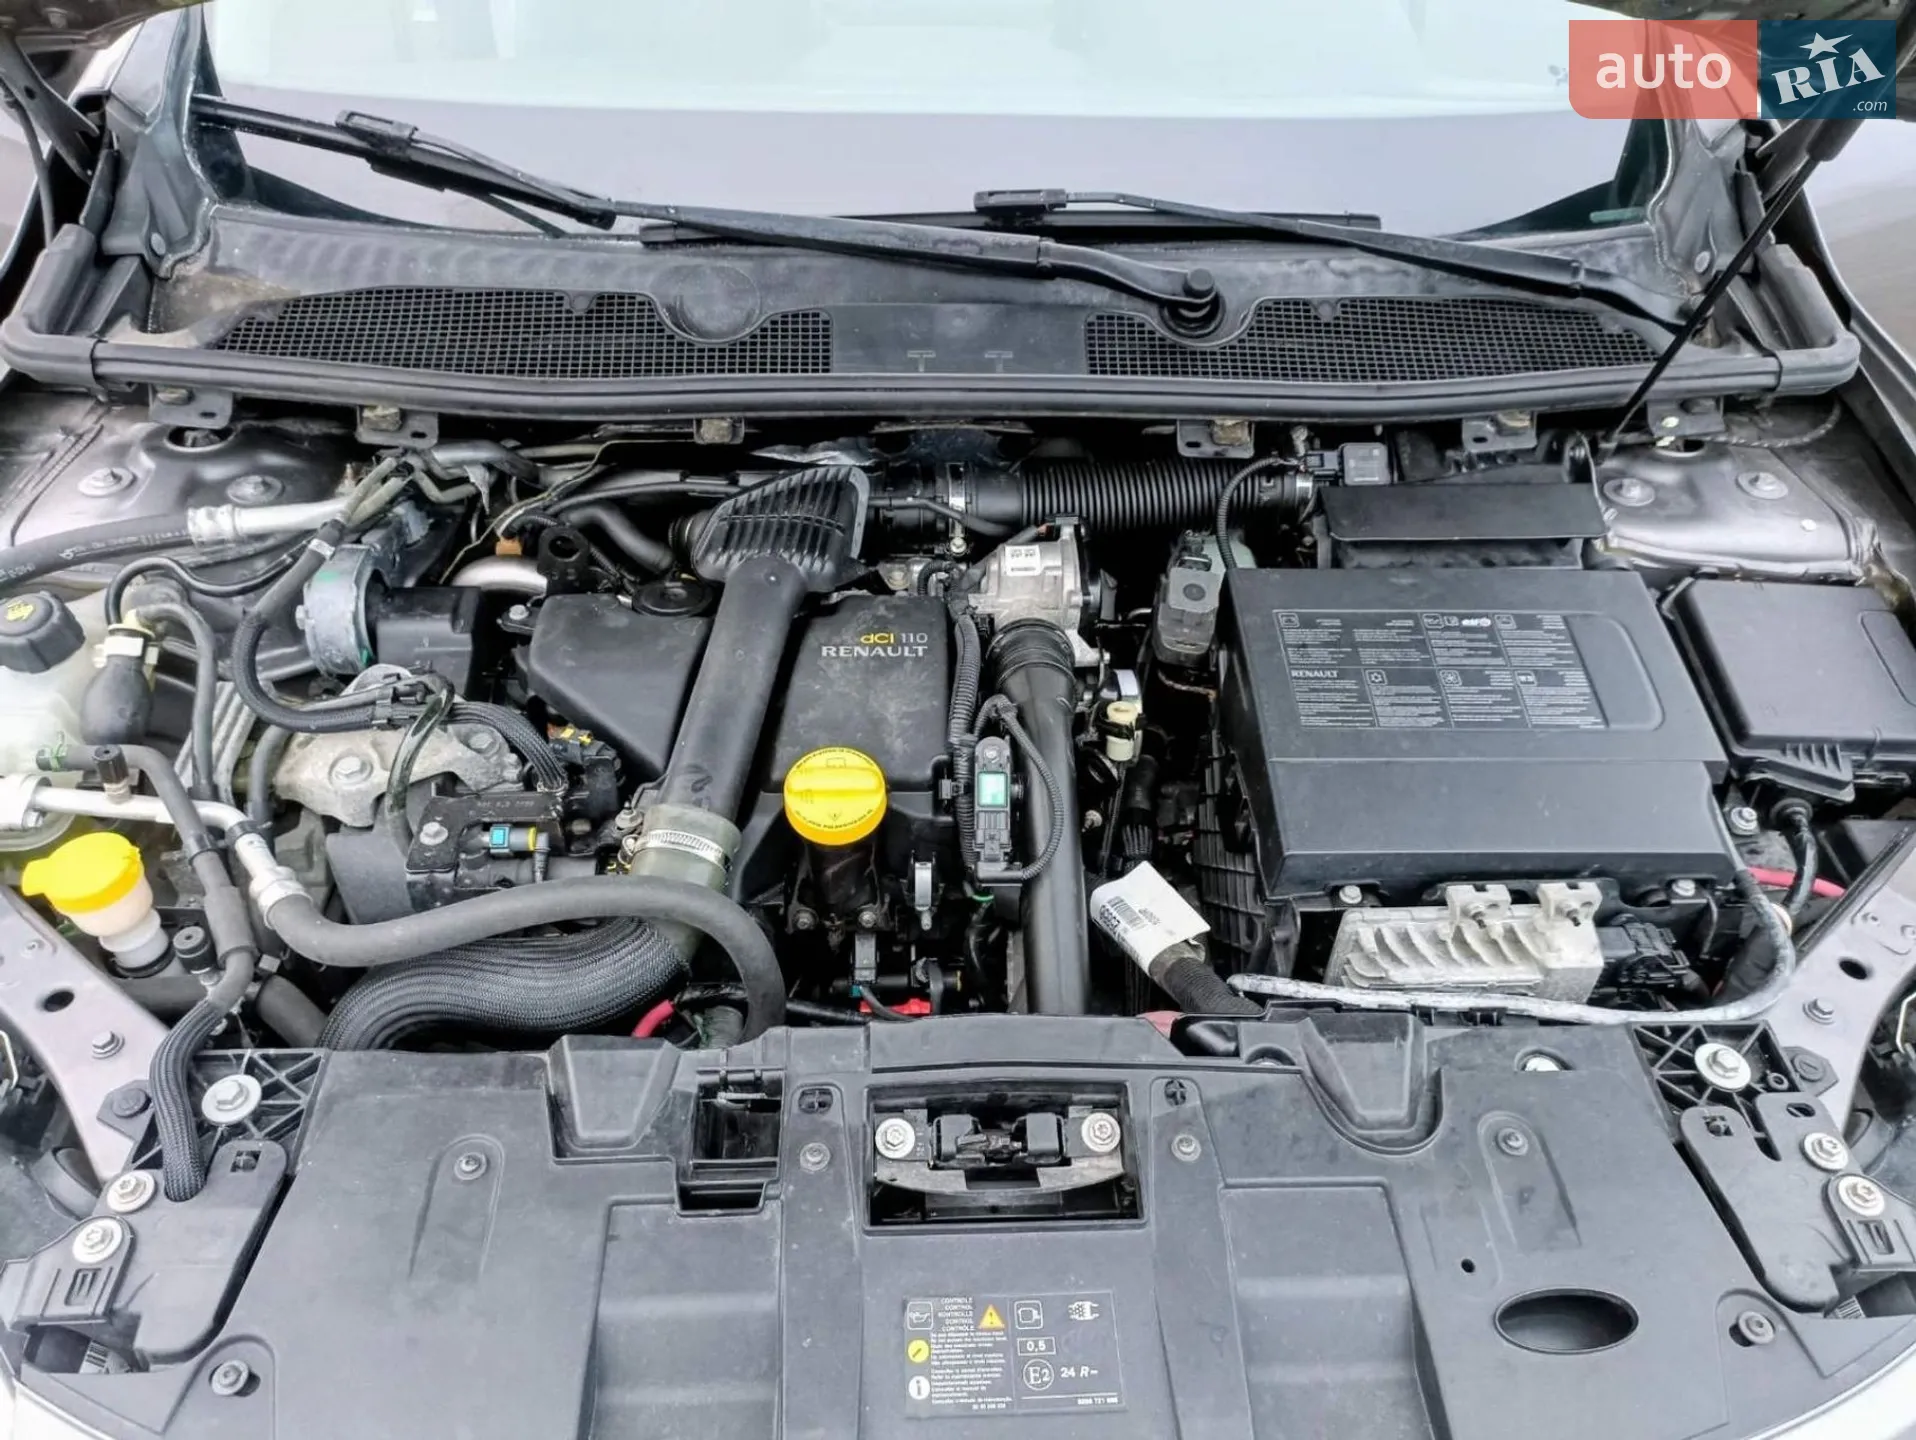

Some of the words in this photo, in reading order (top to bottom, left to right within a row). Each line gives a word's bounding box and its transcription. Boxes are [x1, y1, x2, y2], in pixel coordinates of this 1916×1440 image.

[900, 632, 928, 644] 110
[821, 646, 928, 657] RENAULT
[1290, 670, 1339, 678] RENAULT
[1028, 1366, 1050, 1385] E2
[1060, 1366, 1076, 1378] 24
